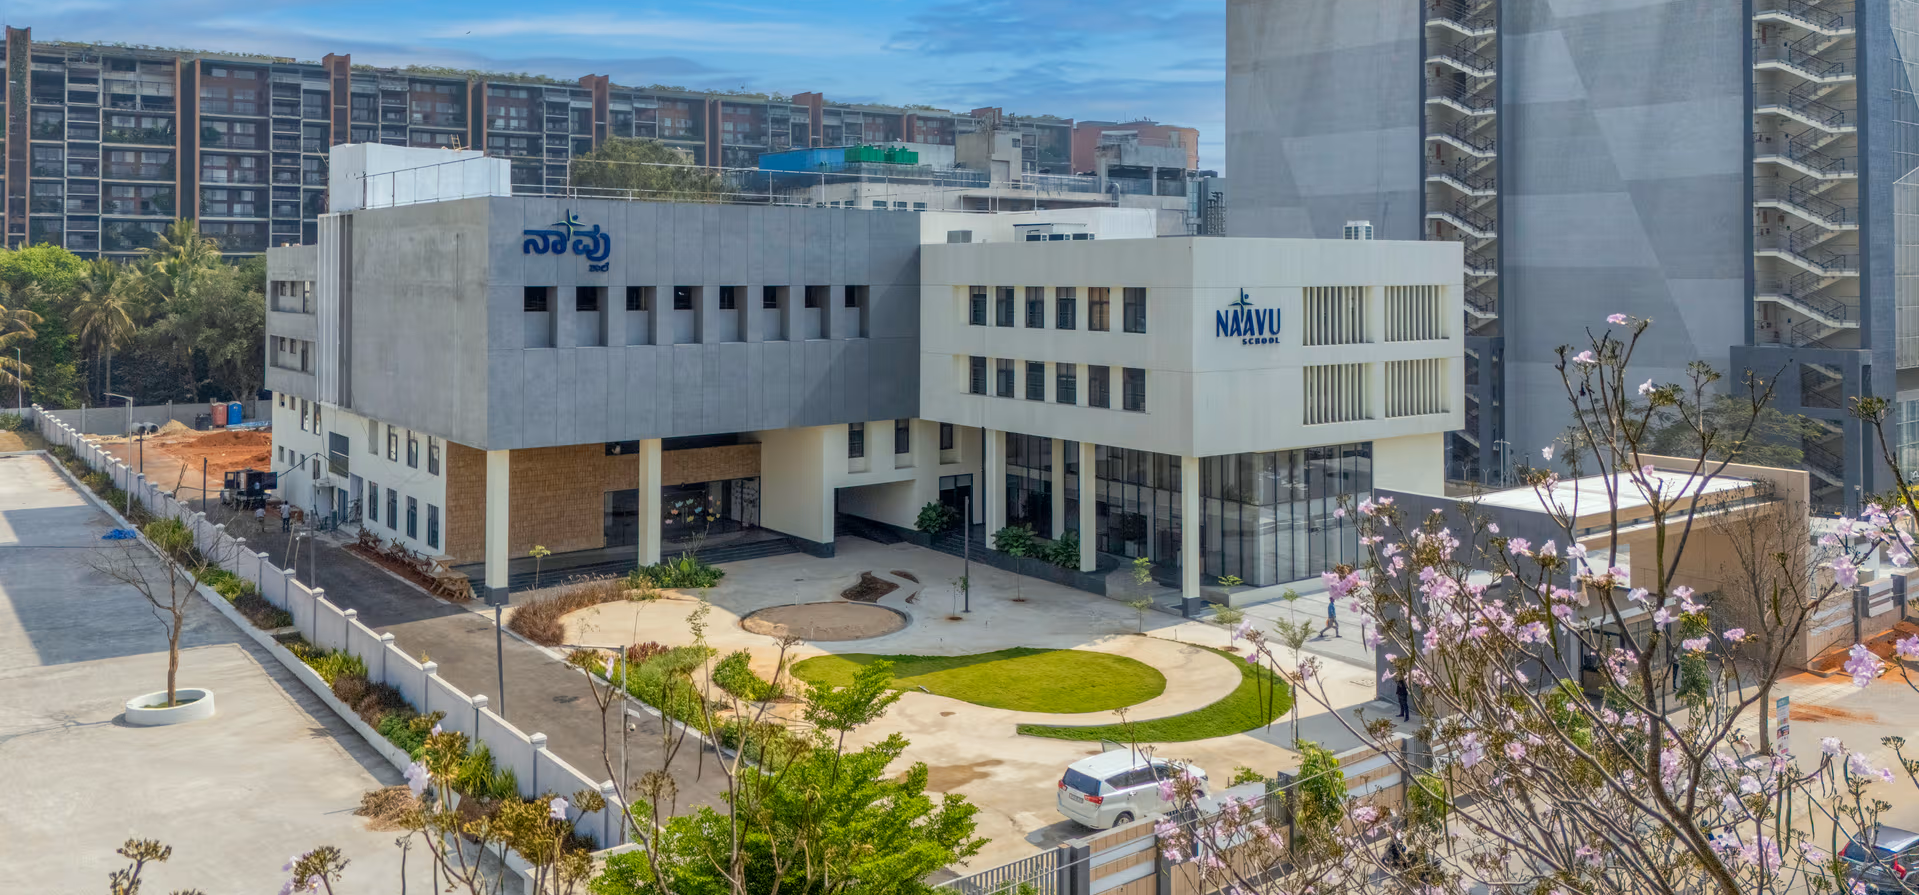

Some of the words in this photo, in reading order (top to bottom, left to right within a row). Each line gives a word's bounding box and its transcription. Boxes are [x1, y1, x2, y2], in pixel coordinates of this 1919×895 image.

[523, 224, 611, 261] ನಾವು
[1216, 308, 1281, 337] NAAVU
[1242, 337, 1281, 345] SCHOOL
